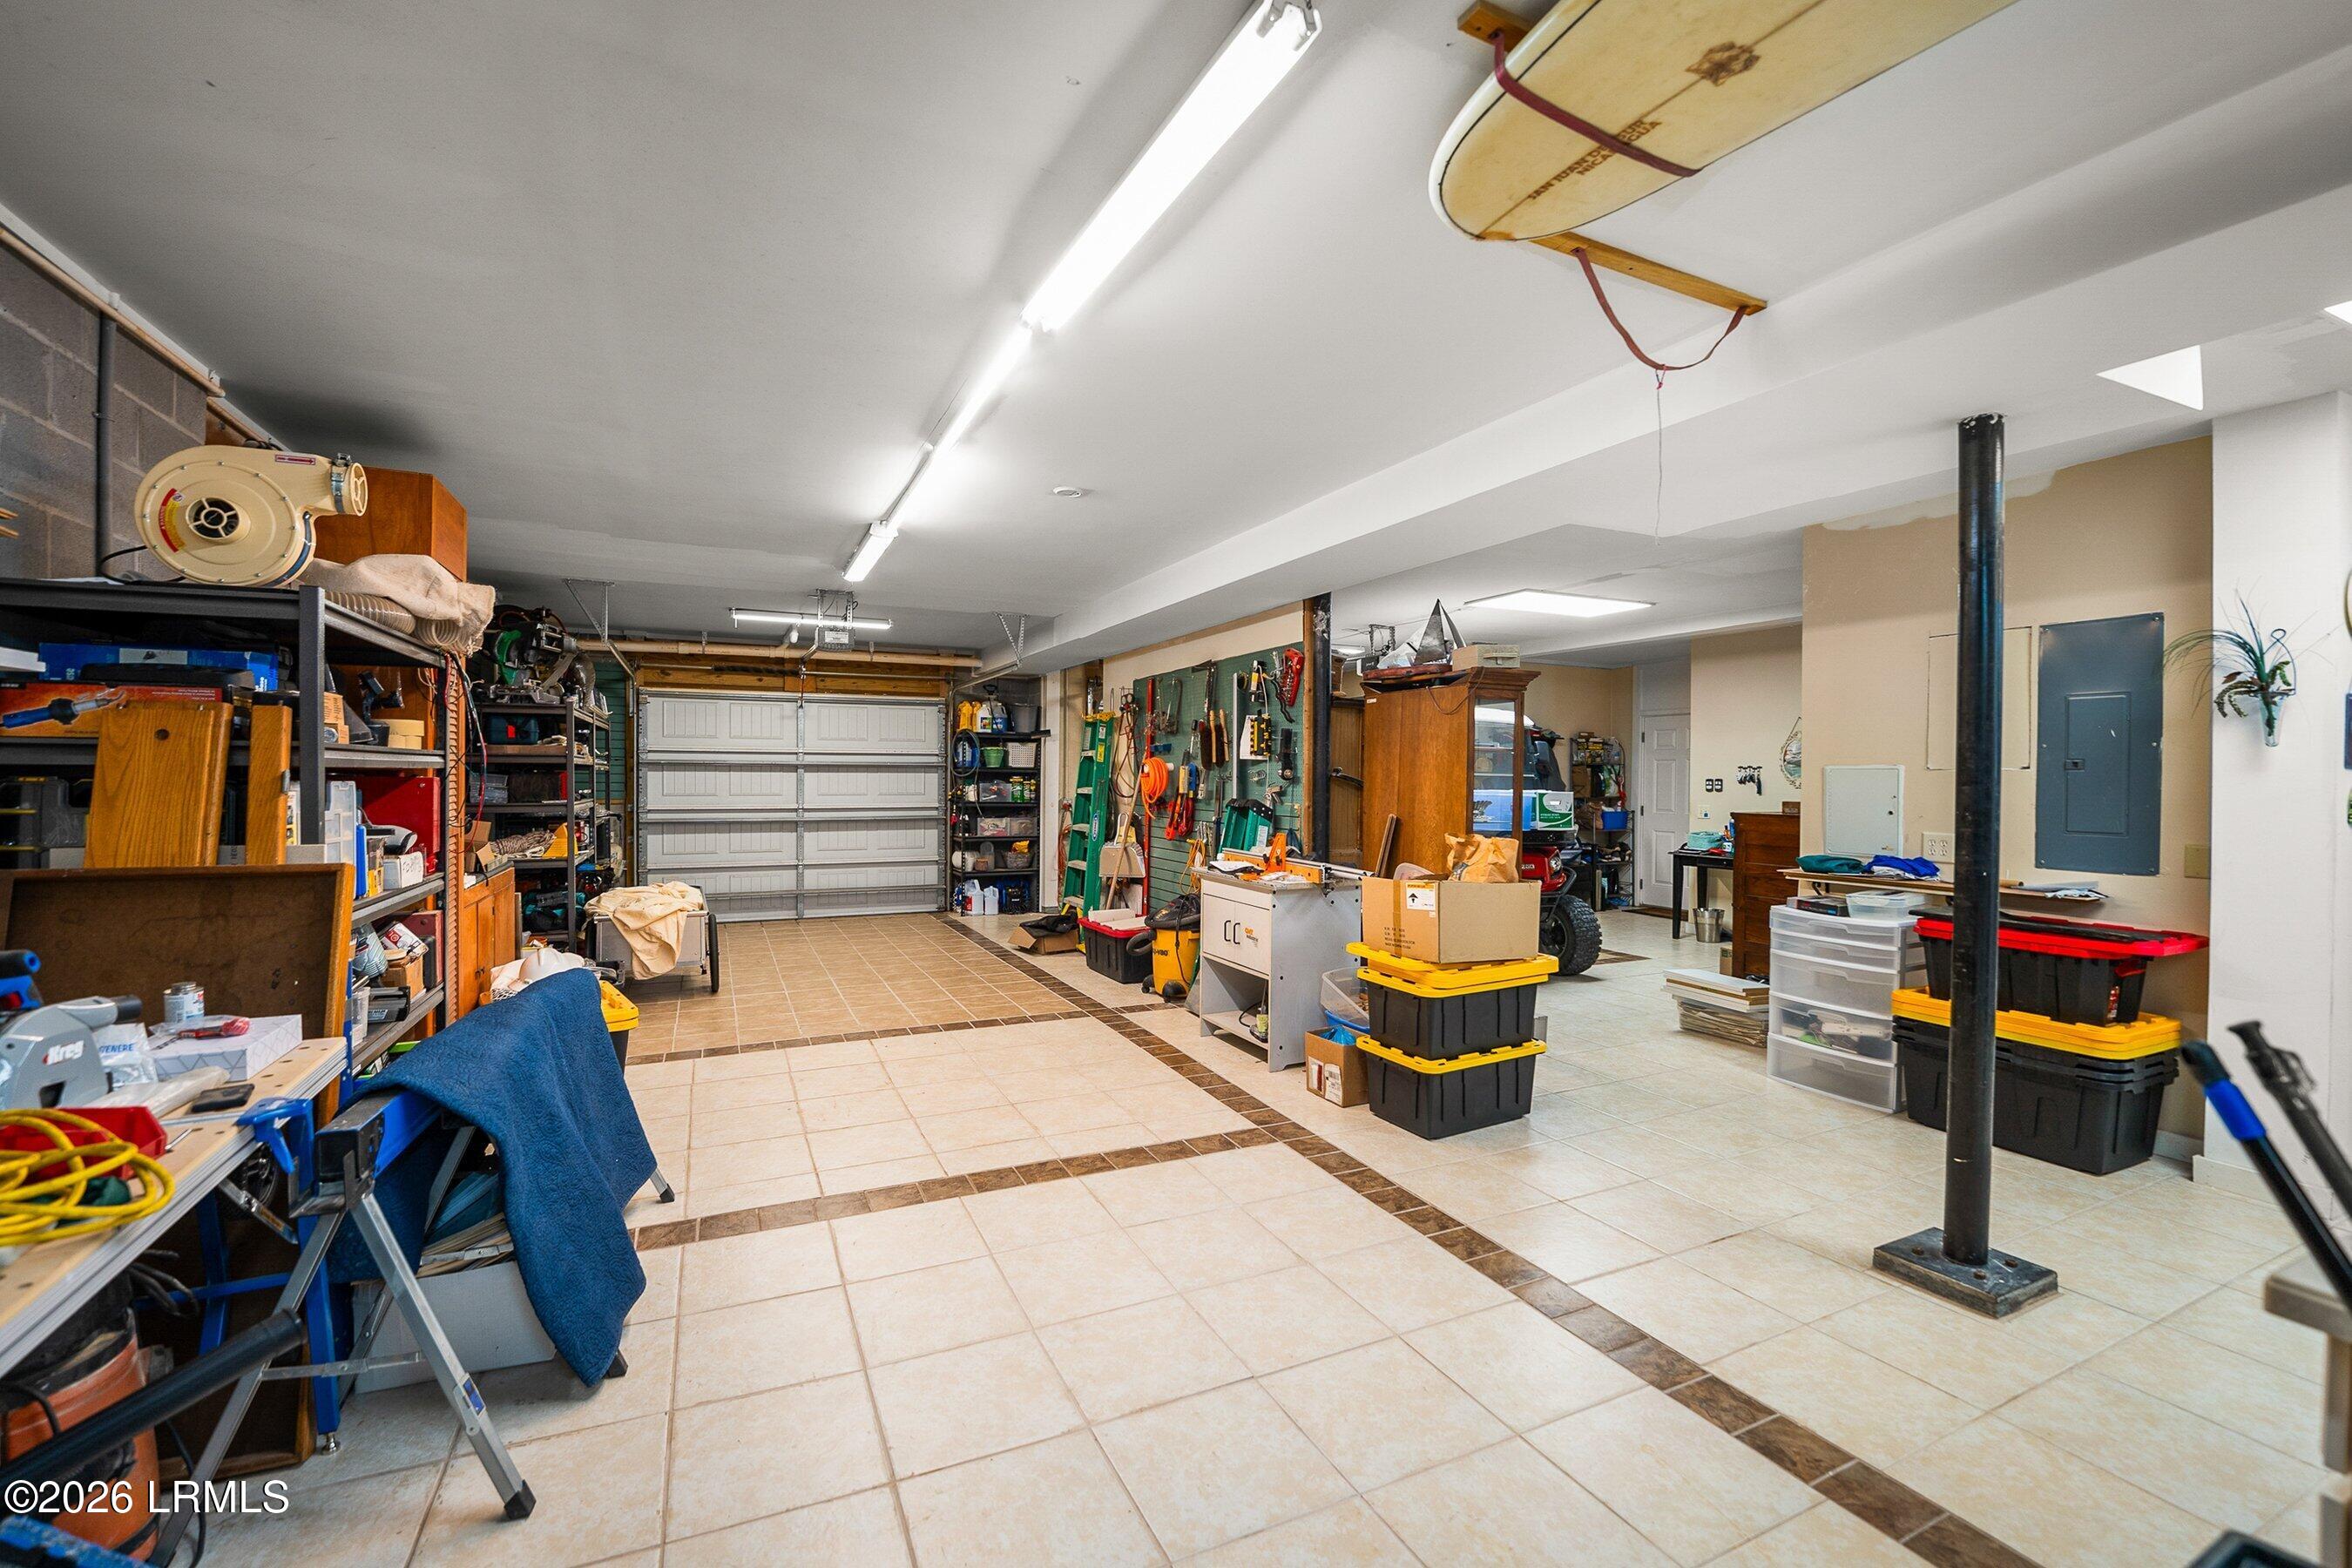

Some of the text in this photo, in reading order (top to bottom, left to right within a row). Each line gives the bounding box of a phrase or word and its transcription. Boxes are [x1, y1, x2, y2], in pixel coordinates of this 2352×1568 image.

[1527, 181, 1555, 200] SAN
[1553, 157, 1590, 182] JUAN
[46, 1040, 84, 1065] Kreg
